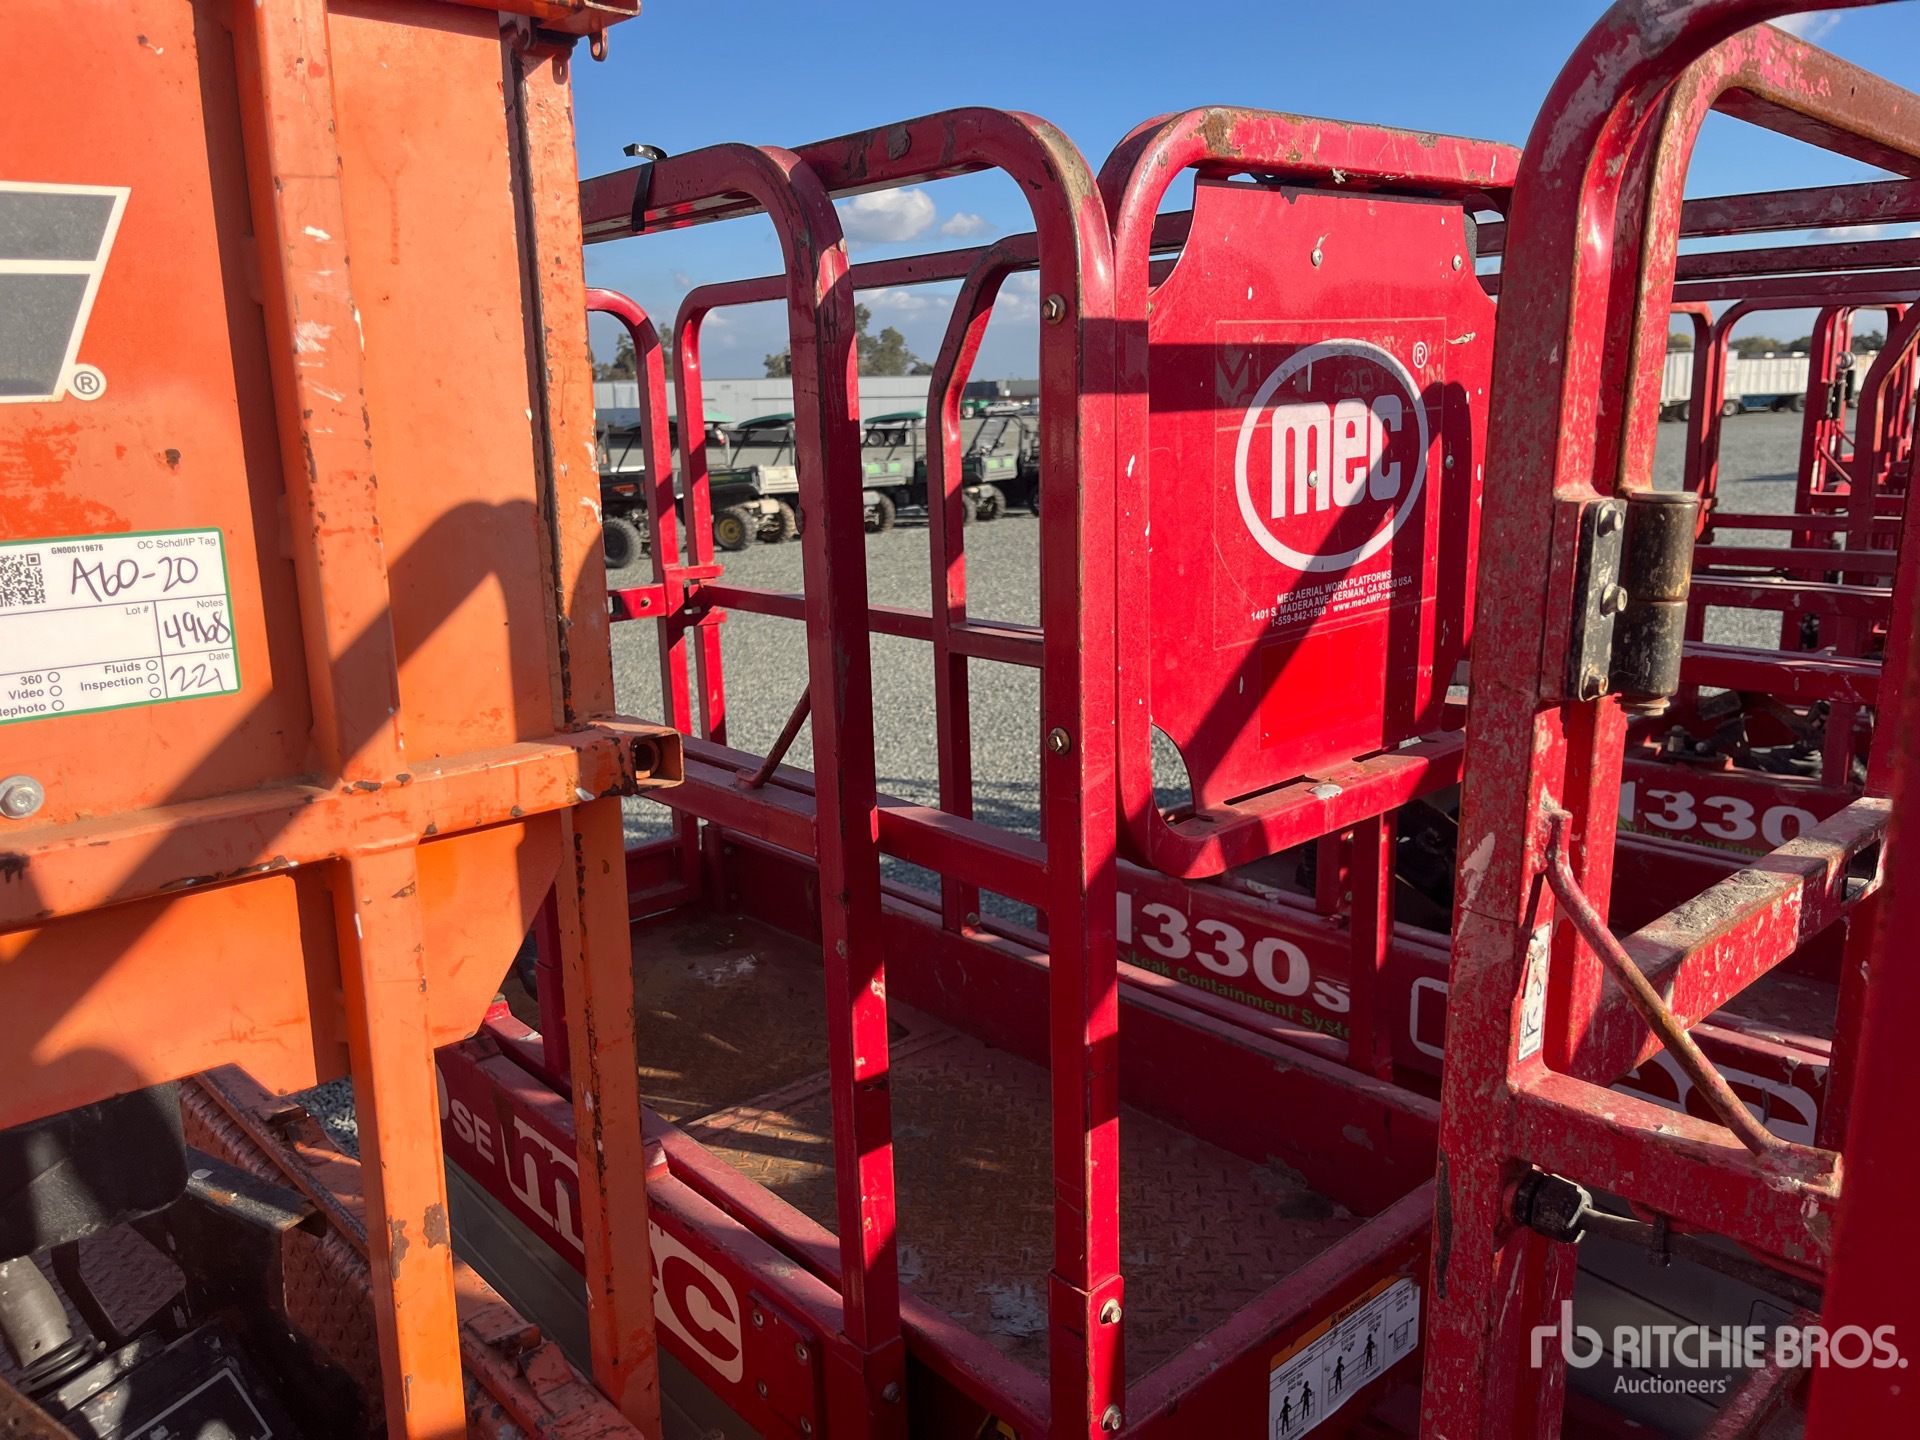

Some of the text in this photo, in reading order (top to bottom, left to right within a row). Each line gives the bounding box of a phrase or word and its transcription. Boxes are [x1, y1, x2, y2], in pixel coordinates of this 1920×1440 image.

[137, 541, 154, 550] OC
[198, 537, 217, 547] Tag
[1277, 569, 1392, 604] MEC AERIAL WORK PLATFORMS
[196, 599, 224, 608] Notes
[1251, 608, 1269, 621] 1401
[1280, 600, 1311, 615] MADERA
[1332, 586, 1366, 602] KERMAN,
[1367, 582, 1377, 594] CA
[1398, 575, 1412, 587] USA
[126, 606, 141, 615] Lot
[209, 652, 230, 661] Date
[104, 662, 141, 674] Fluids
[20, 674, 42, 686] 360
[80, 676, 143, 691] Inspection
[8, 688, 44, 700] Video
[1176, 966, 1296, 1019] Containment
